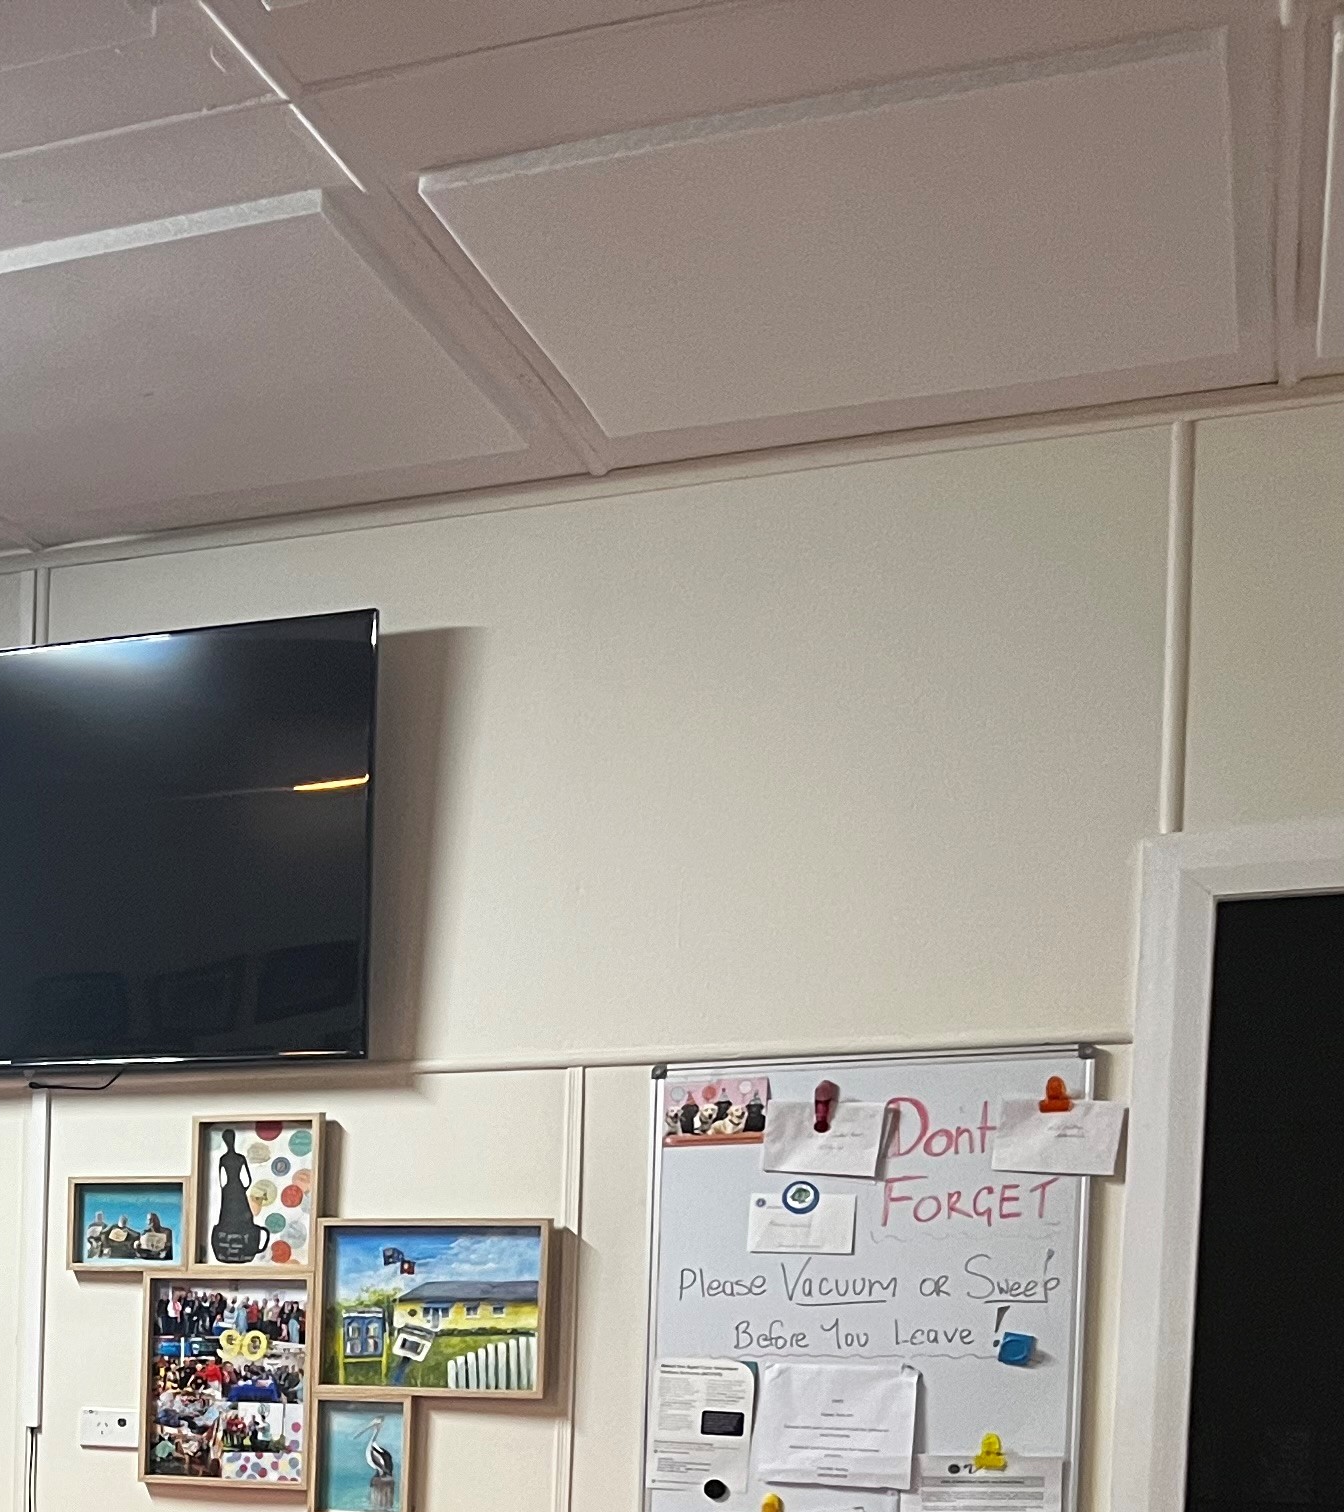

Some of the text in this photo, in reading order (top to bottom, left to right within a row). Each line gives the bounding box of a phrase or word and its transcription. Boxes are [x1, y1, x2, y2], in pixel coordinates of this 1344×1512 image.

[884, 1097, 998, 1159] Dont
[881, 1175, 1061, 1228] FORGET
[679, 1267, 767, 1301] Please
[780, 1256, 897, 1299] Vacuum
[964, 1250, 1060, 1302] Sweep
[733, 1319, 810, 1351] Before
[820, 1317, 870, 1348] You
